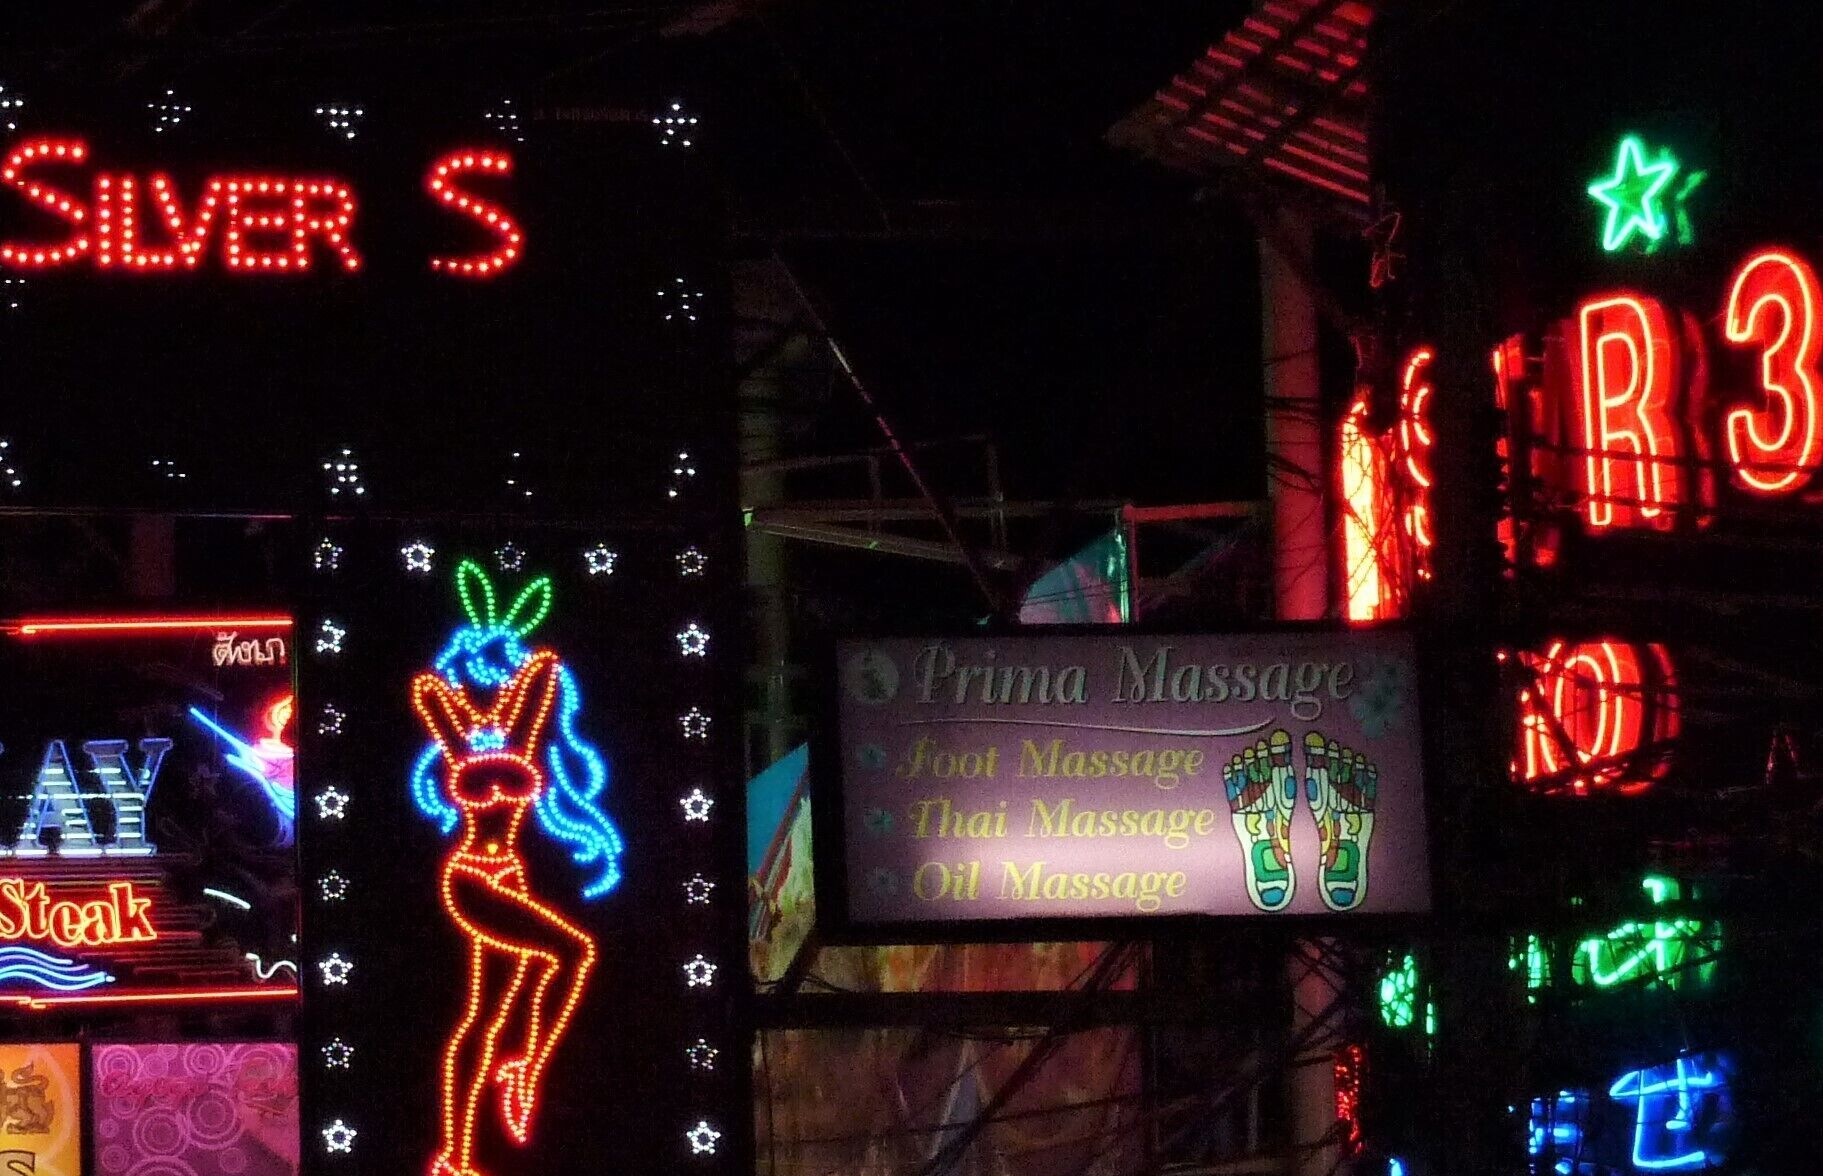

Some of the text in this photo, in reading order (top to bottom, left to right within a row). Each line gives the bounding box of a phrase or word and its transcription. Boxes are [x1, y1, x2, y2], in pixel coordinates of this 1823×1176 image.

[0, 136, 520, 275] SILVER S
[912, 643, 1356, 721] Prima Massage
[896, 736, 1204, 789] Foot Massage
[910, 797, 1216, 850] Thai Massage
[912, 860, 1188, 912] Oil Massage
